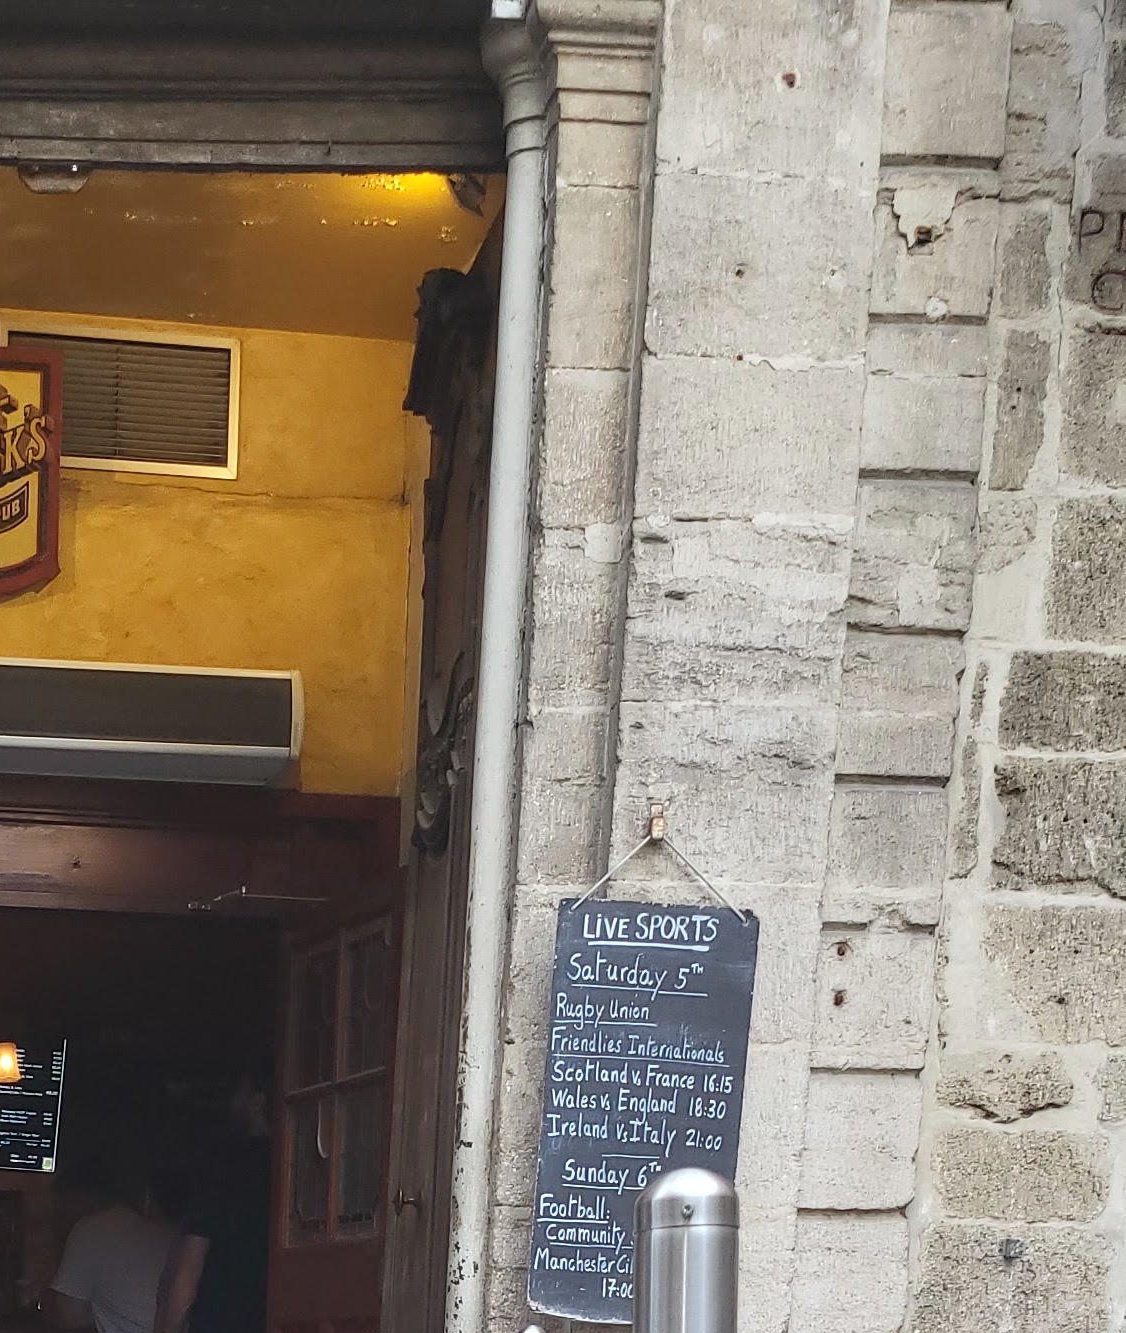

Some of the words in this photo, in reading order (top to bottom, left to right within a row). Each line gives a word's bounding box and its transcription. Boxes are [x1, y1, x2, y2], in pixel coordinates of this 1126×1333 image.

[635, 912, 720, 942] SPORTS
[566, 951, 668, 1001] Saturday
[555, 992, 605, 1031] Rugby
[609, 999, 650, 1020] Union
[551, 1026, 622, 1055] Friendlies
[627, 1034, 725, 1064] Internationals
[551, 1059, 628, 1085] Scotland
[646, 1064, 695, 1090] France
[703, 1074, 734, 1094] 16:15
[551, 1084, 597, 1109] Wales
[617, 1087, 678, 1124] England
[688, 1096, 727, 1120] 18:30
[546, 1112, 609, 1138] Ireland
[629, 1118, 677, 1158] Italy
[685, 1128, 723, 1151] 21:00
[561, 1158, 630, 1195] Sunday
[538, 1193, 611, 1220] Football:
[545, 1220, 626, 1256] Community
[533, 1247, 615, 1274] Manchester
